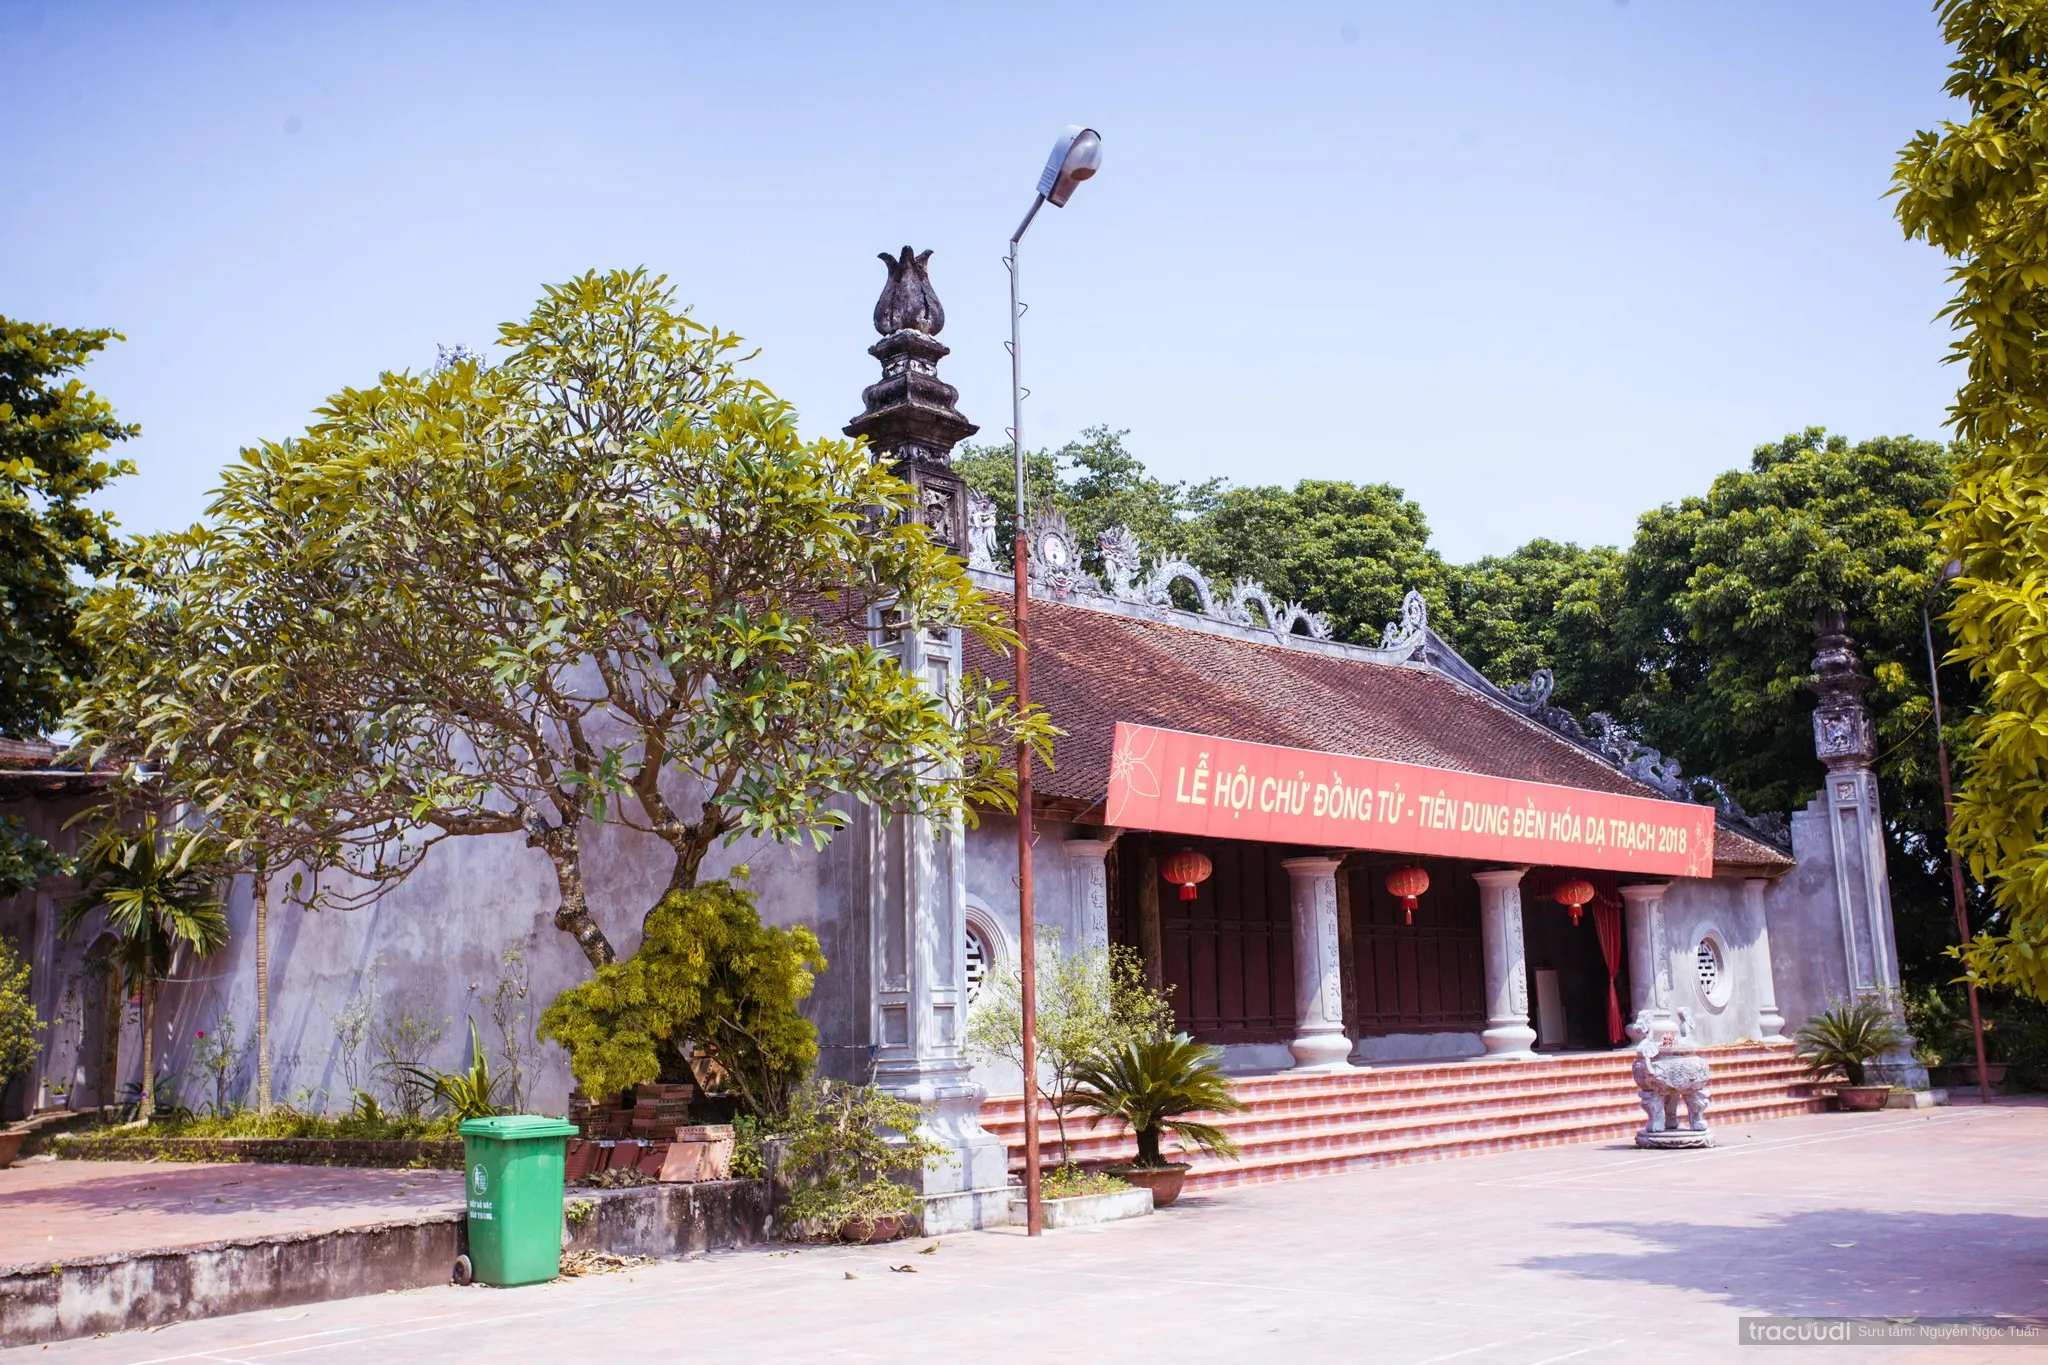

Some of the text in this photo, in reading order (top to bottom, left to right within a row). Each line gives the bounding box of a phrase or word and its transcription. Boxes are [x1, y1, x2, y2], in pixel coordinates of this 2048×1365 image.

[1176, 752, 1210, 806] LỄ
[1214, 765, 1255, 819] HỘI
[1260, 770, 1310, 816] CHỬ
[1313, 770, 1372, 821] ĐỒNG
[1378, 782, 1405, 824] TỬ
[1418, 790, 1459, 830] TIÊN
[1461, 802, 1509, 837] DUNG
[1513, 796, 1545, 840] ĐỀN
[1549, 806, 1582, 843] HÓA
[1585, 818, 1606, 853] DẠ
[1609, 819, 1656, 856] TRẠCH
[1658, 827, 1687, 854] 2018
